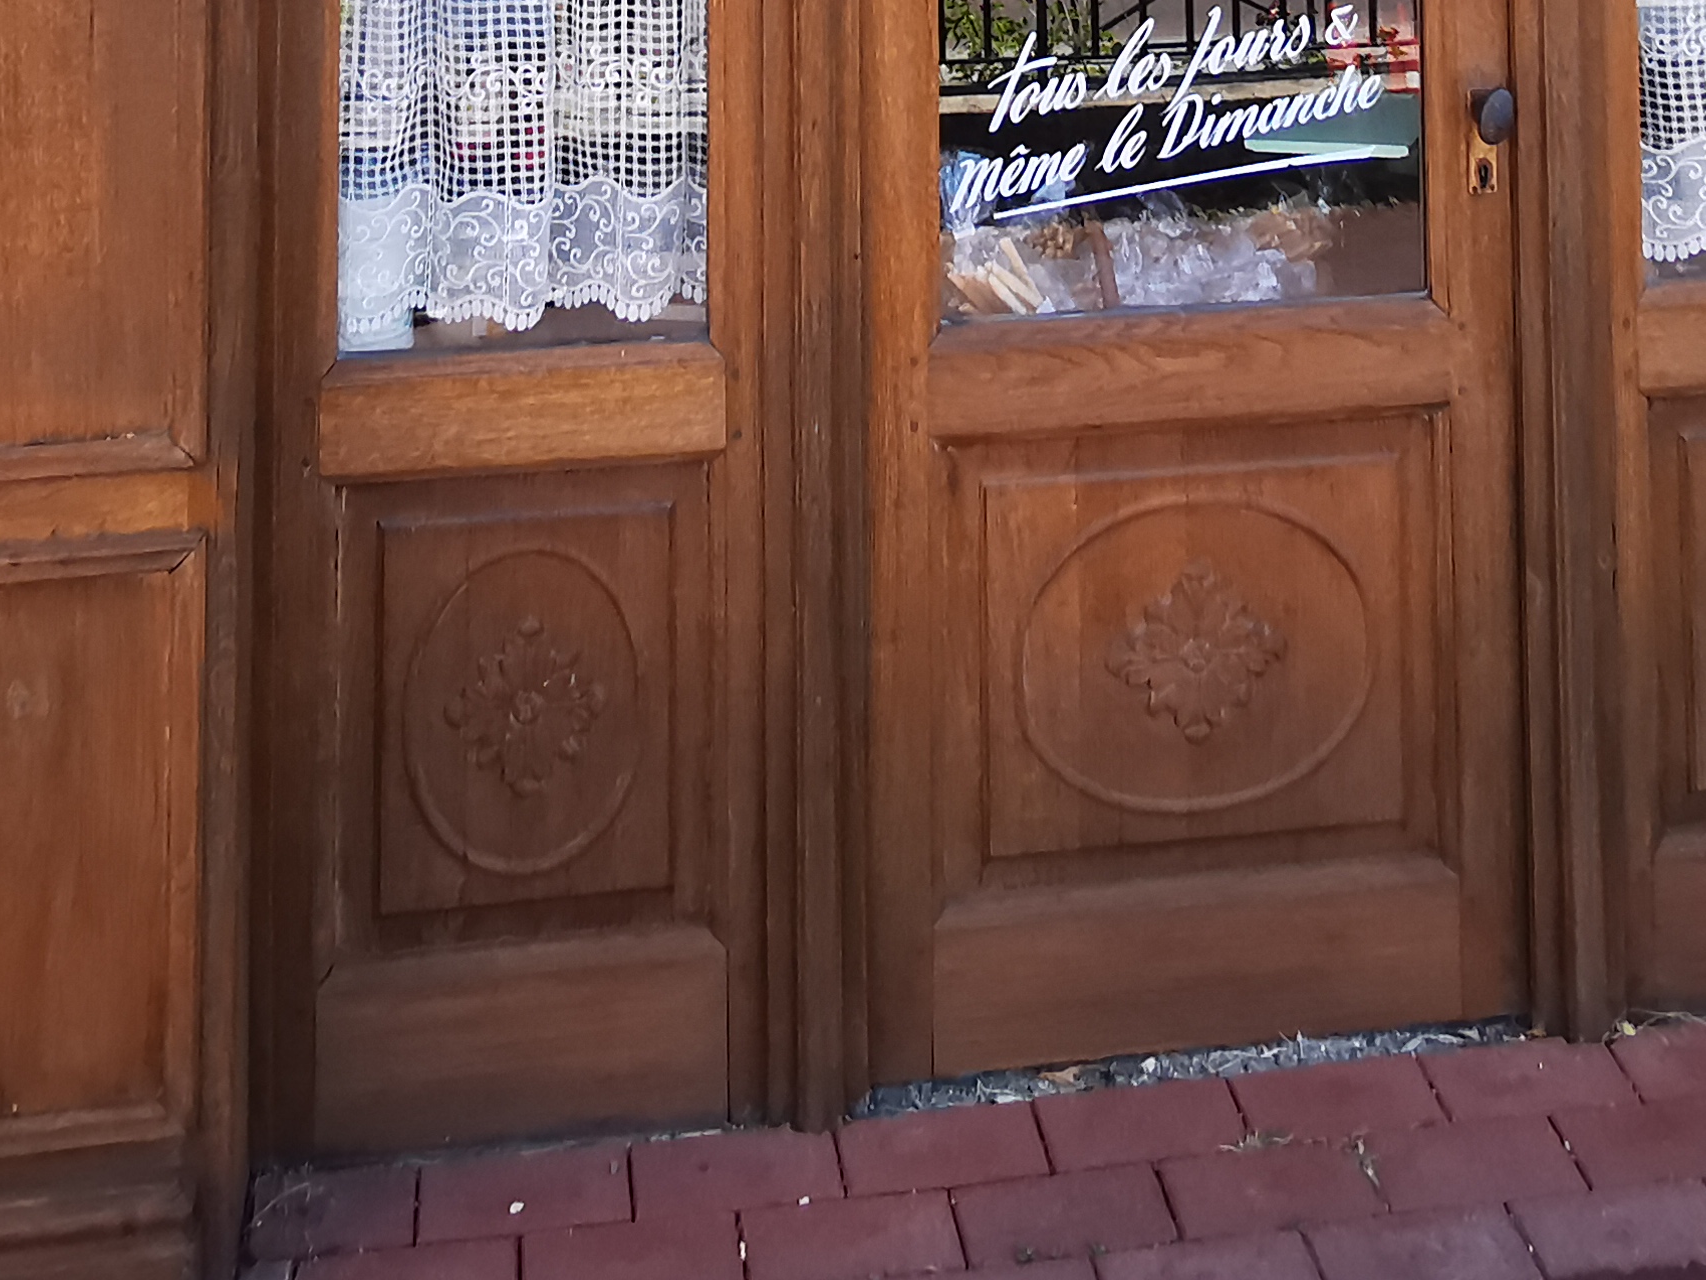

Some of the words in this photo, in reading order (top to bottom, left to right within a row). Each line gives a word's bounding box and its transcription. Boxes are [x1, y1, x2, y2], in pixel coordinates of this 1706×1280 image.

[988, 31, 1088, 133] tous
[1093, 17, 1172, 102] les
[1324, 4, 1359, 48] &
[949, 142, 1088, 214] même
[1095, 103, 1148, 174] le
[1157, 64, 1385, 160] Dimanche
